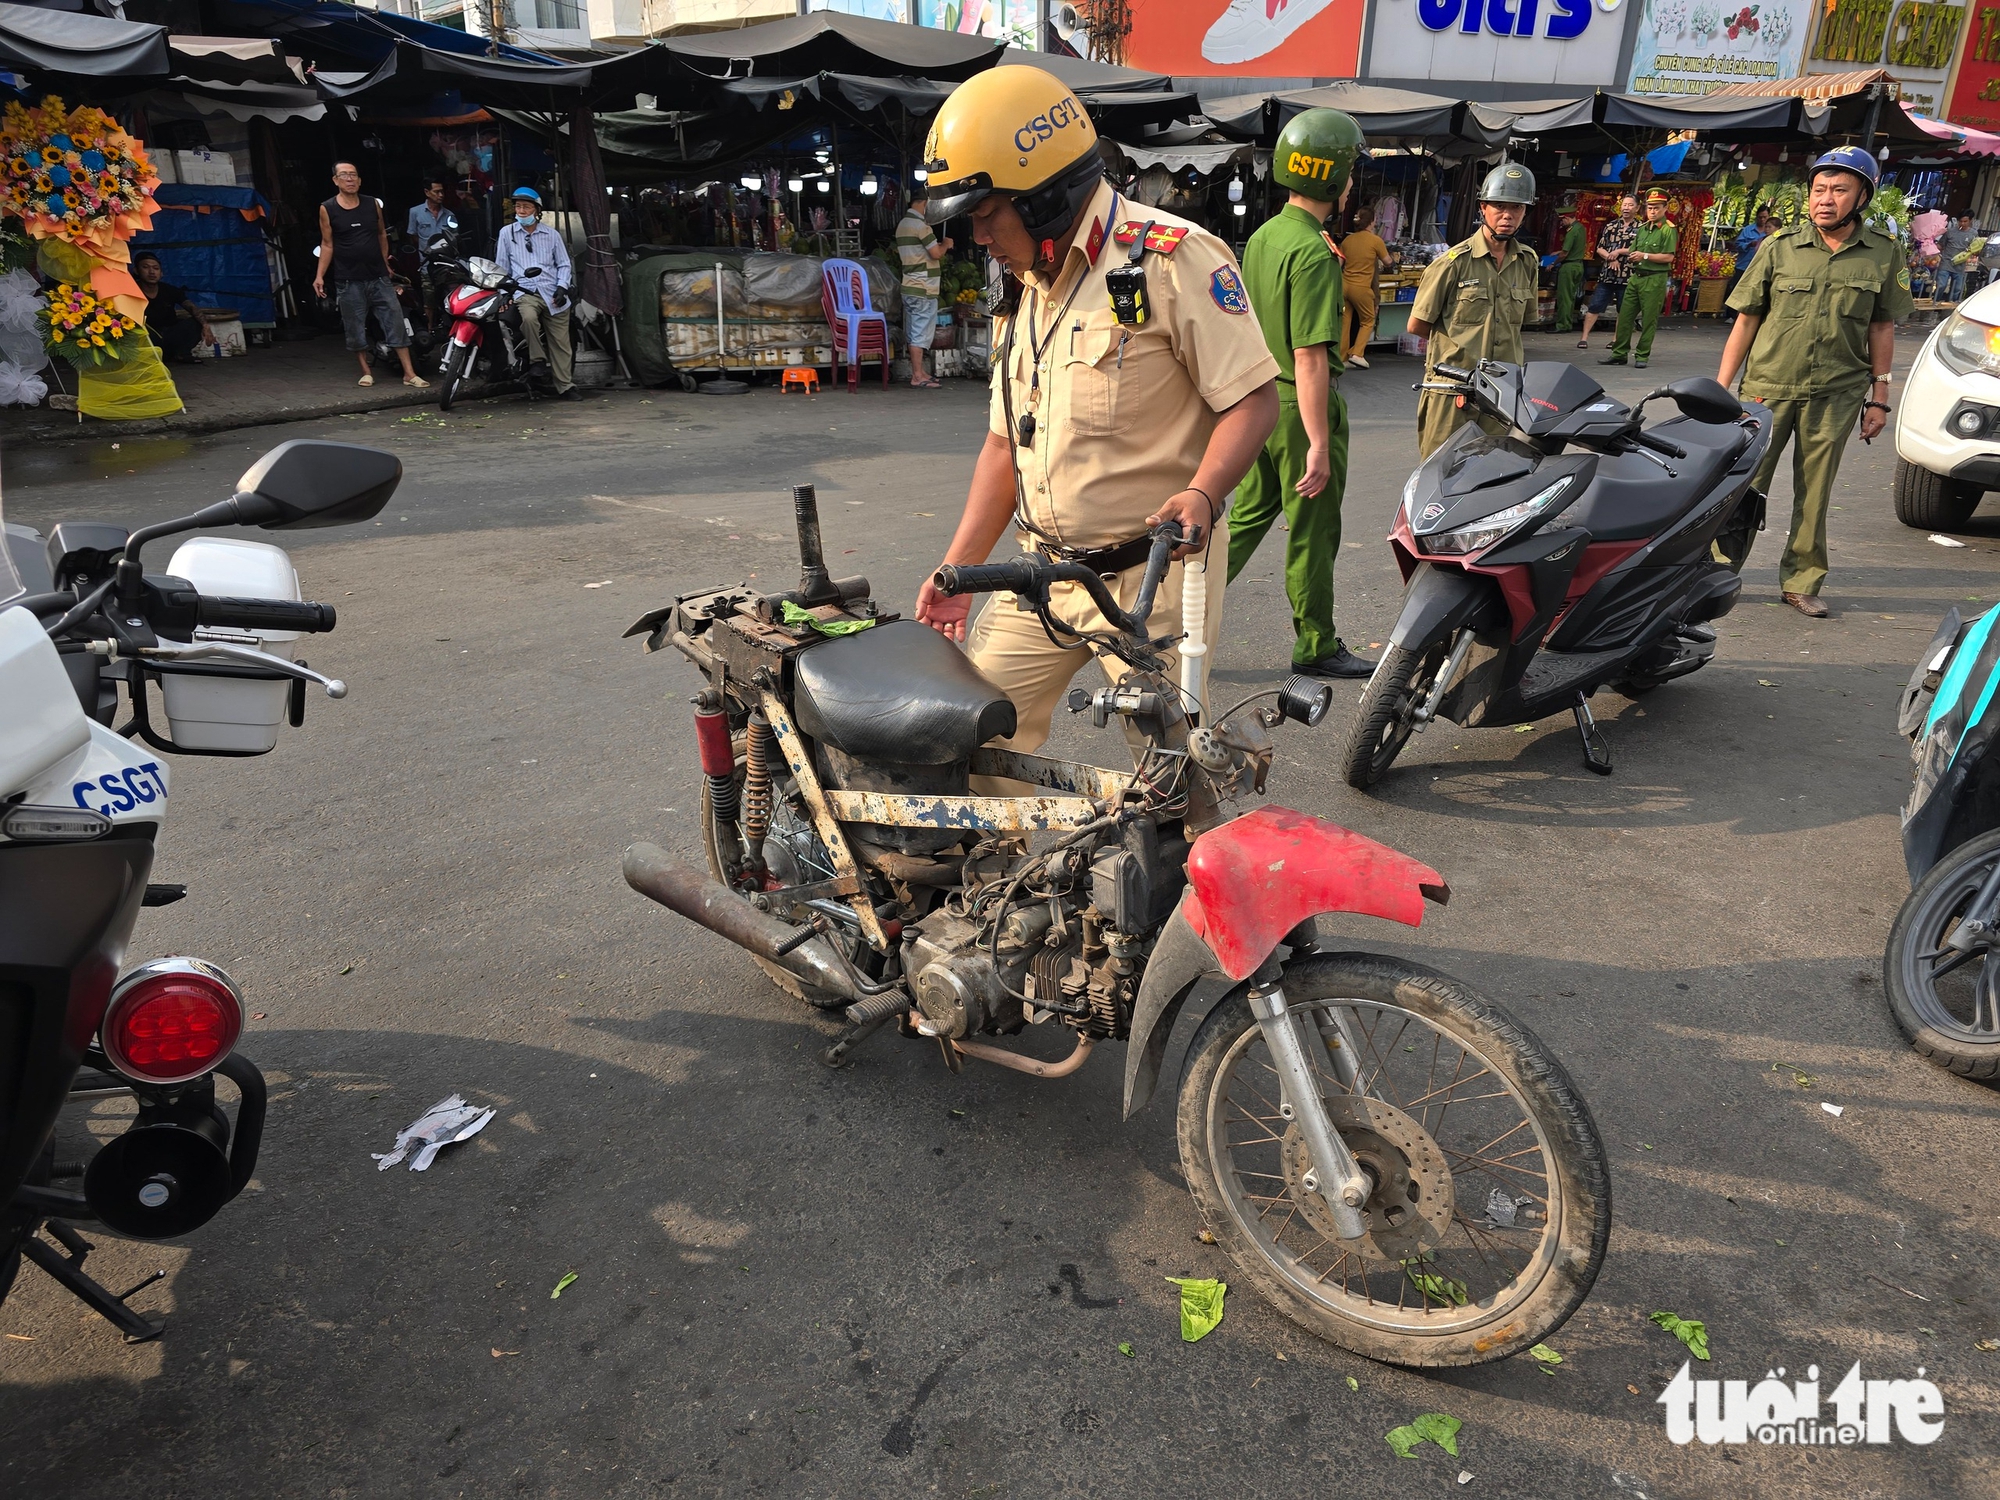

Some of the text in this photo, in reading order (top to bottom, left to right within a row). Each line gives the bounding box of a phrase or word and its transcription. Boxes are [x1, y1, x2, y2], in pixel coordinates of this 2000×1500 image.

[1654, 53, 1682, 71] CHUYÊN
[1682, 56, 1702, 72] CUNG
[1763, 61, 1778, 76] HOA
[1634, 74, 1655, 95] NHẬN
[1670, 78, 1686, 94] HOA
[1685, 79, 1702, 95] KHAI
[1014, 96, 1080, 153] CSGT
[1287, 151, 1335, 181] CSTT
[1530, 397, 1559, 412] HONDA
